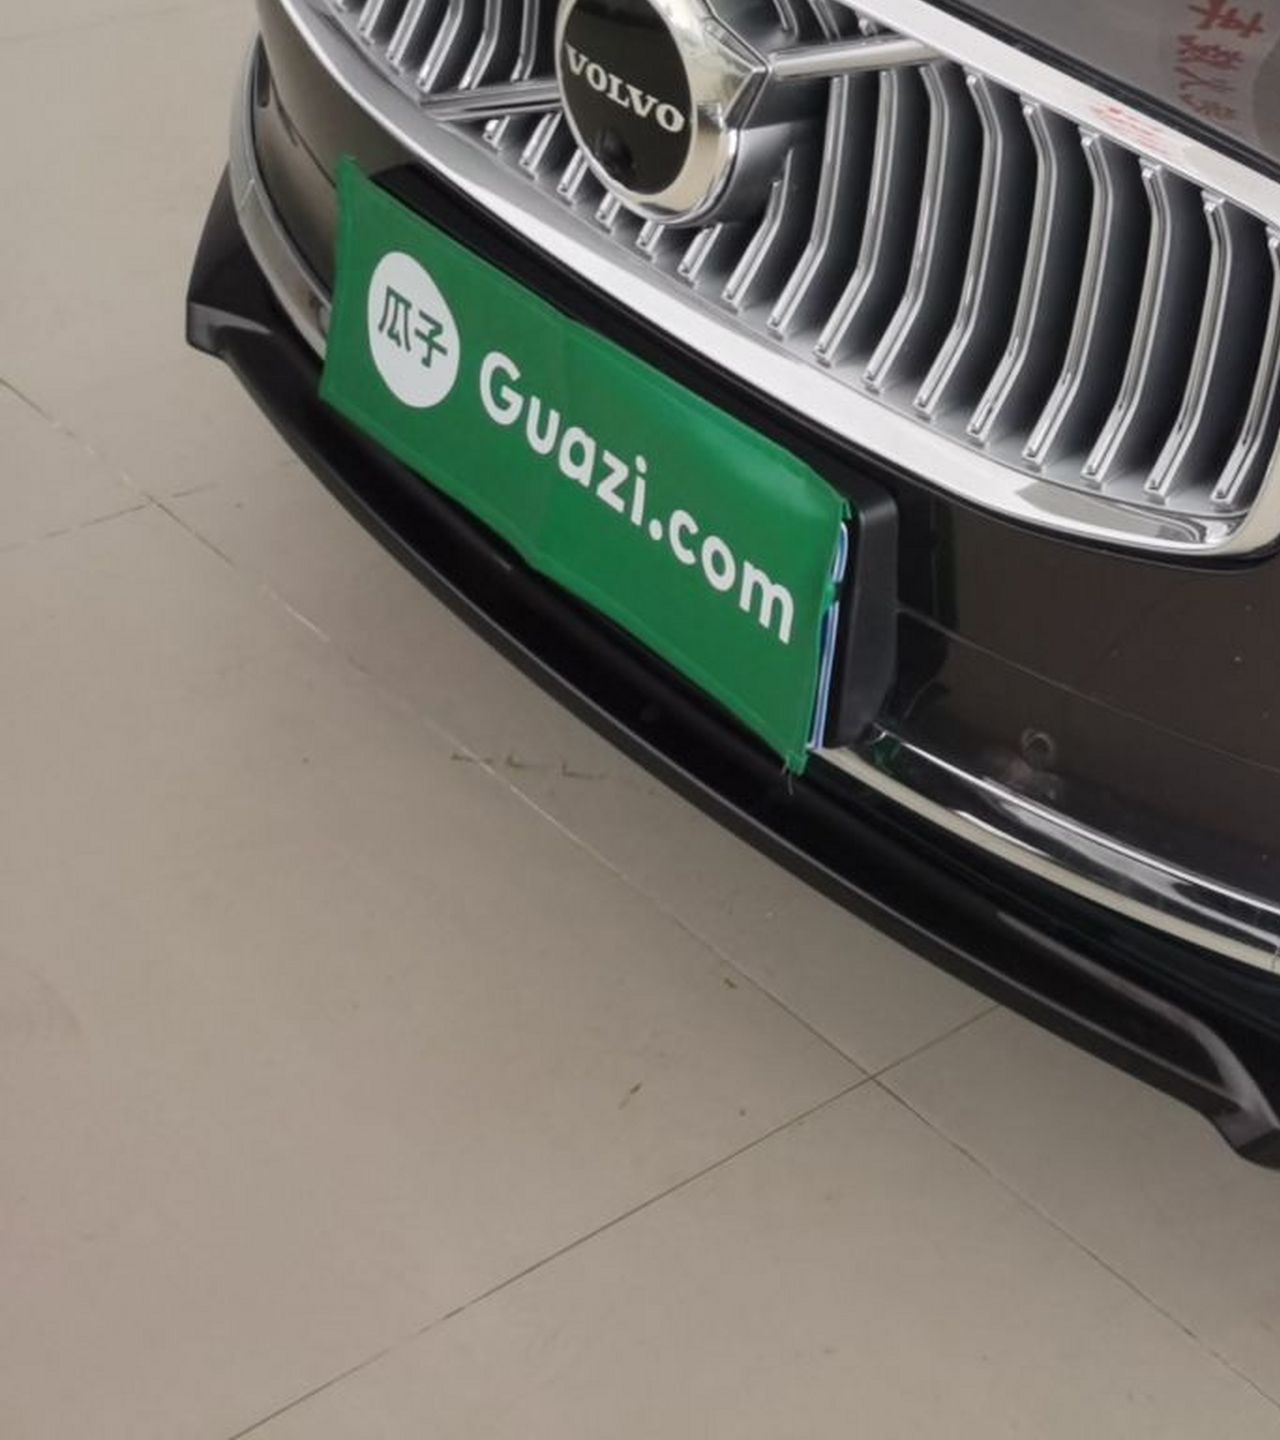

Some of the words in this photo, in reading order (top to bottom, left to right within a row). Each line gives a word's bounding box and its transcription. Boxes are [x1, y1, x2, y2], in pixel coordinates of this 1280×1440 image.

[564, 41, 686, 134] VOLVO
[377, 284, 449, 369] 瓜子
[478, 349, 796, 645] Guazi.com
